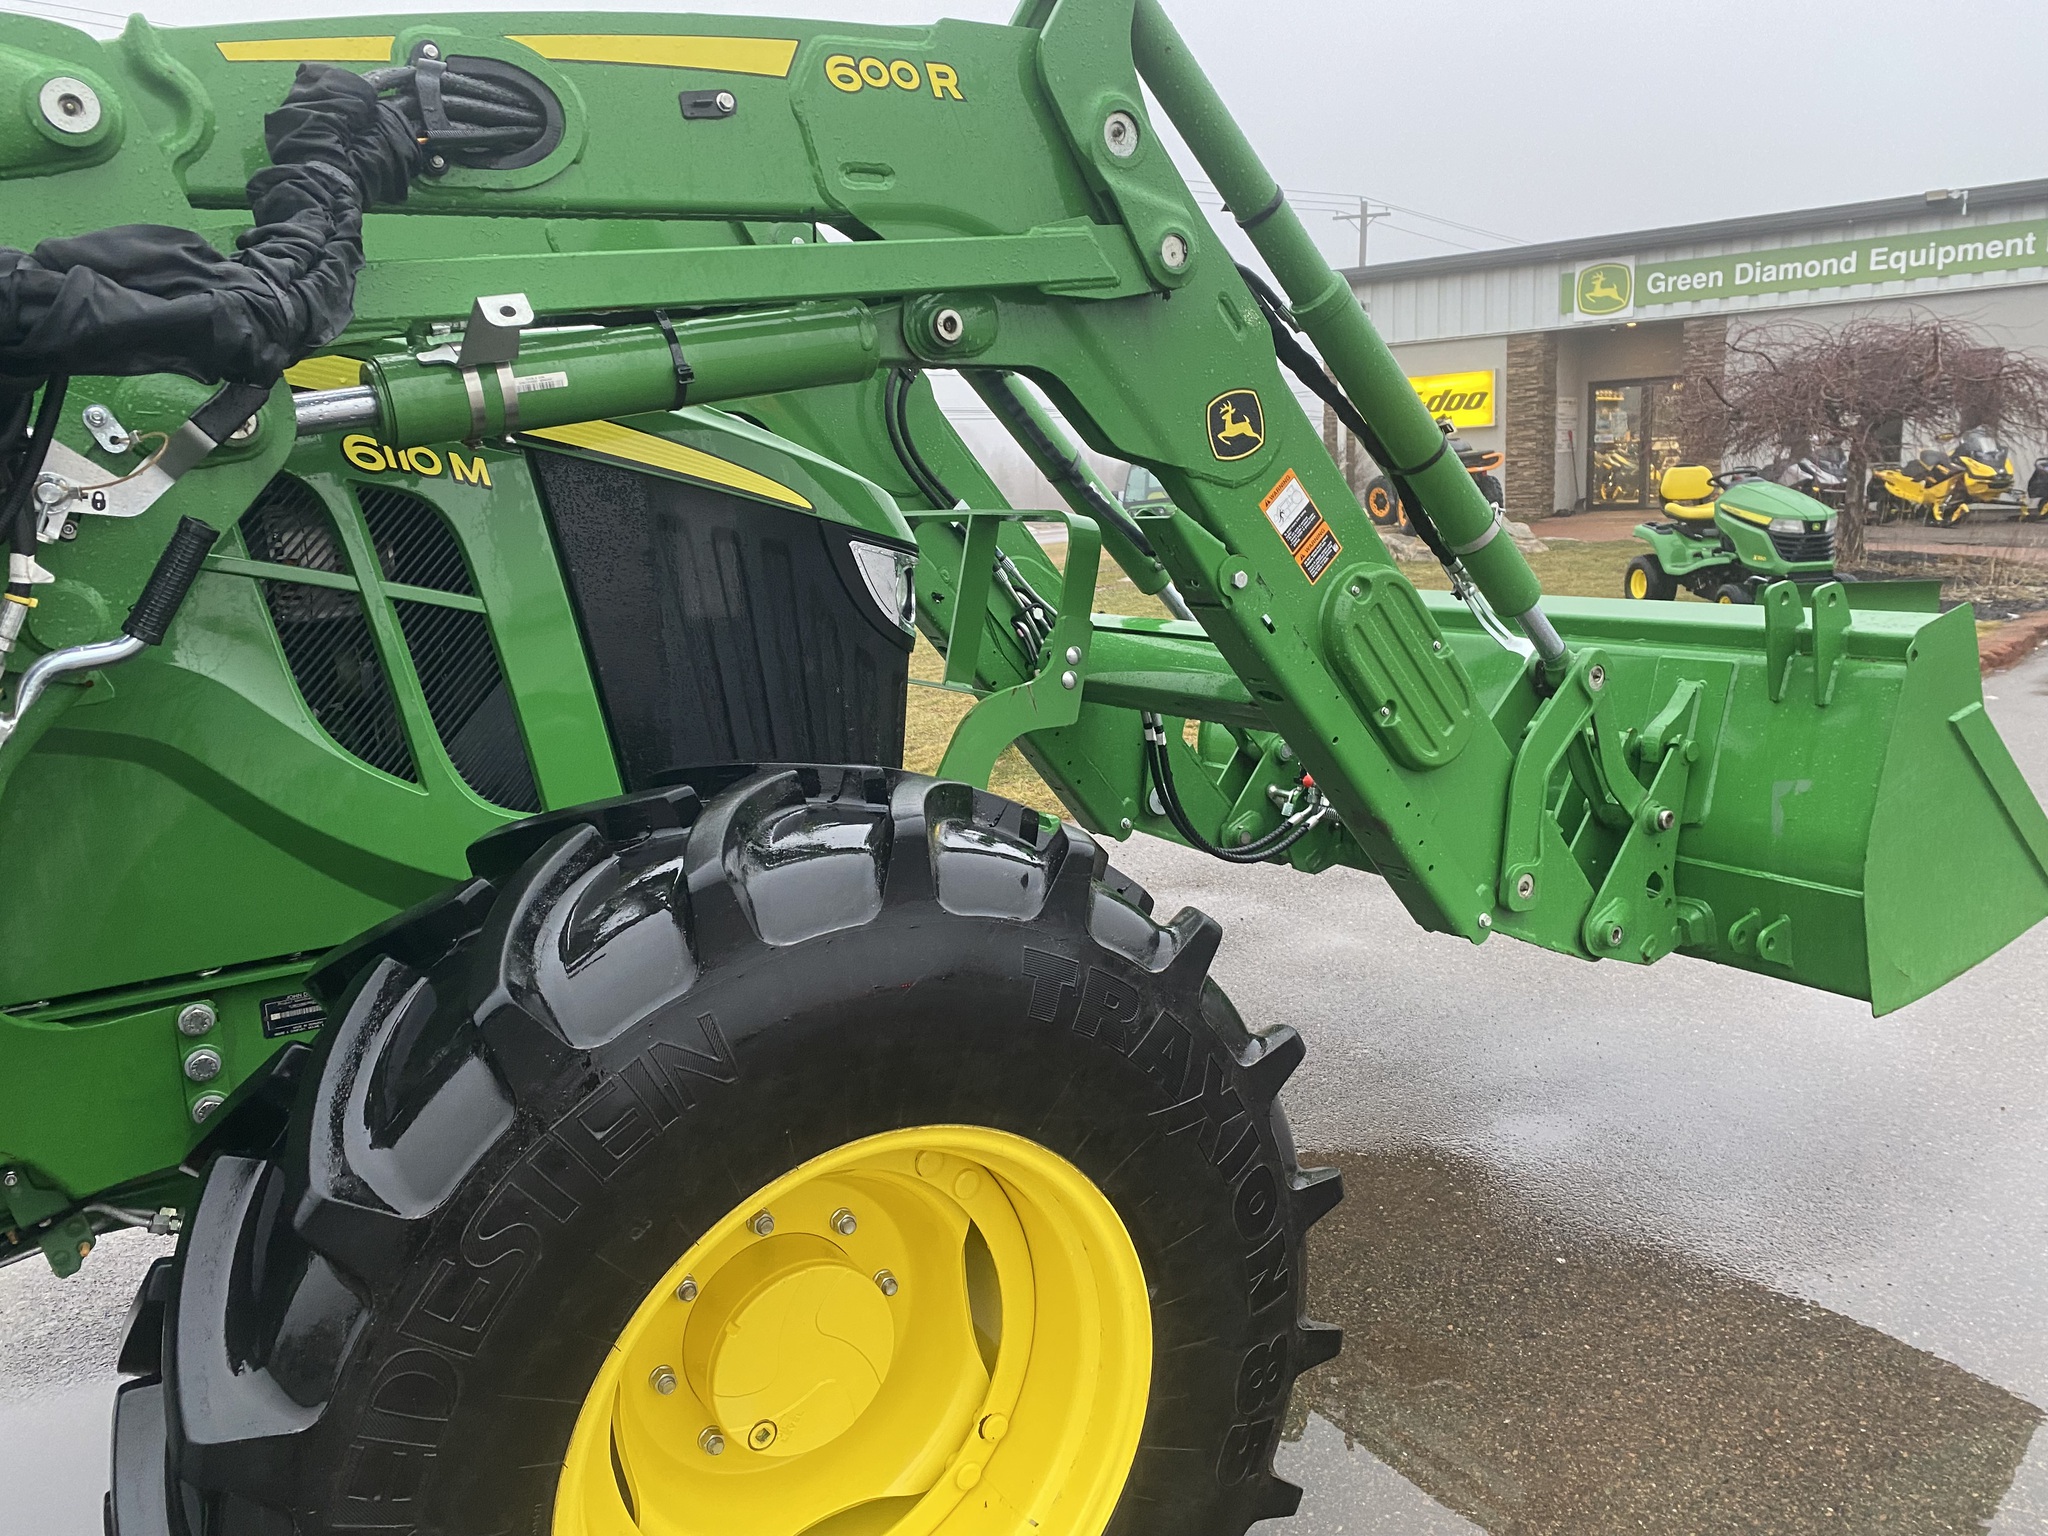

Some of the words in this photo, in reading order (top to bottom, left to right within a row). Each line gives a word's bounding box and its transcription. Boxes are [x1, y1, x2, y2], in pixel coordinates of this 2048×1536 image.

[824, 54, 921, 93] 600
[924, 60, 967, 102] R
[1646, 269, 1723, 295] Green
[1734, 251, 1857, 286] Diamond
[1869, 231, 2037, 274] Equipment
[341, 433, 443, 477] 6110
[448, 451, 494, 489] M
[1269, 474, 1291, 501] WARNING
[1305, 528, 1326, 553] WARNING
[1022, 945, 1289, 1317] TRAXION
[1216, 1334, 1288, 1489] 85
[331, 1011, 743, 1536] EDESTEIN
